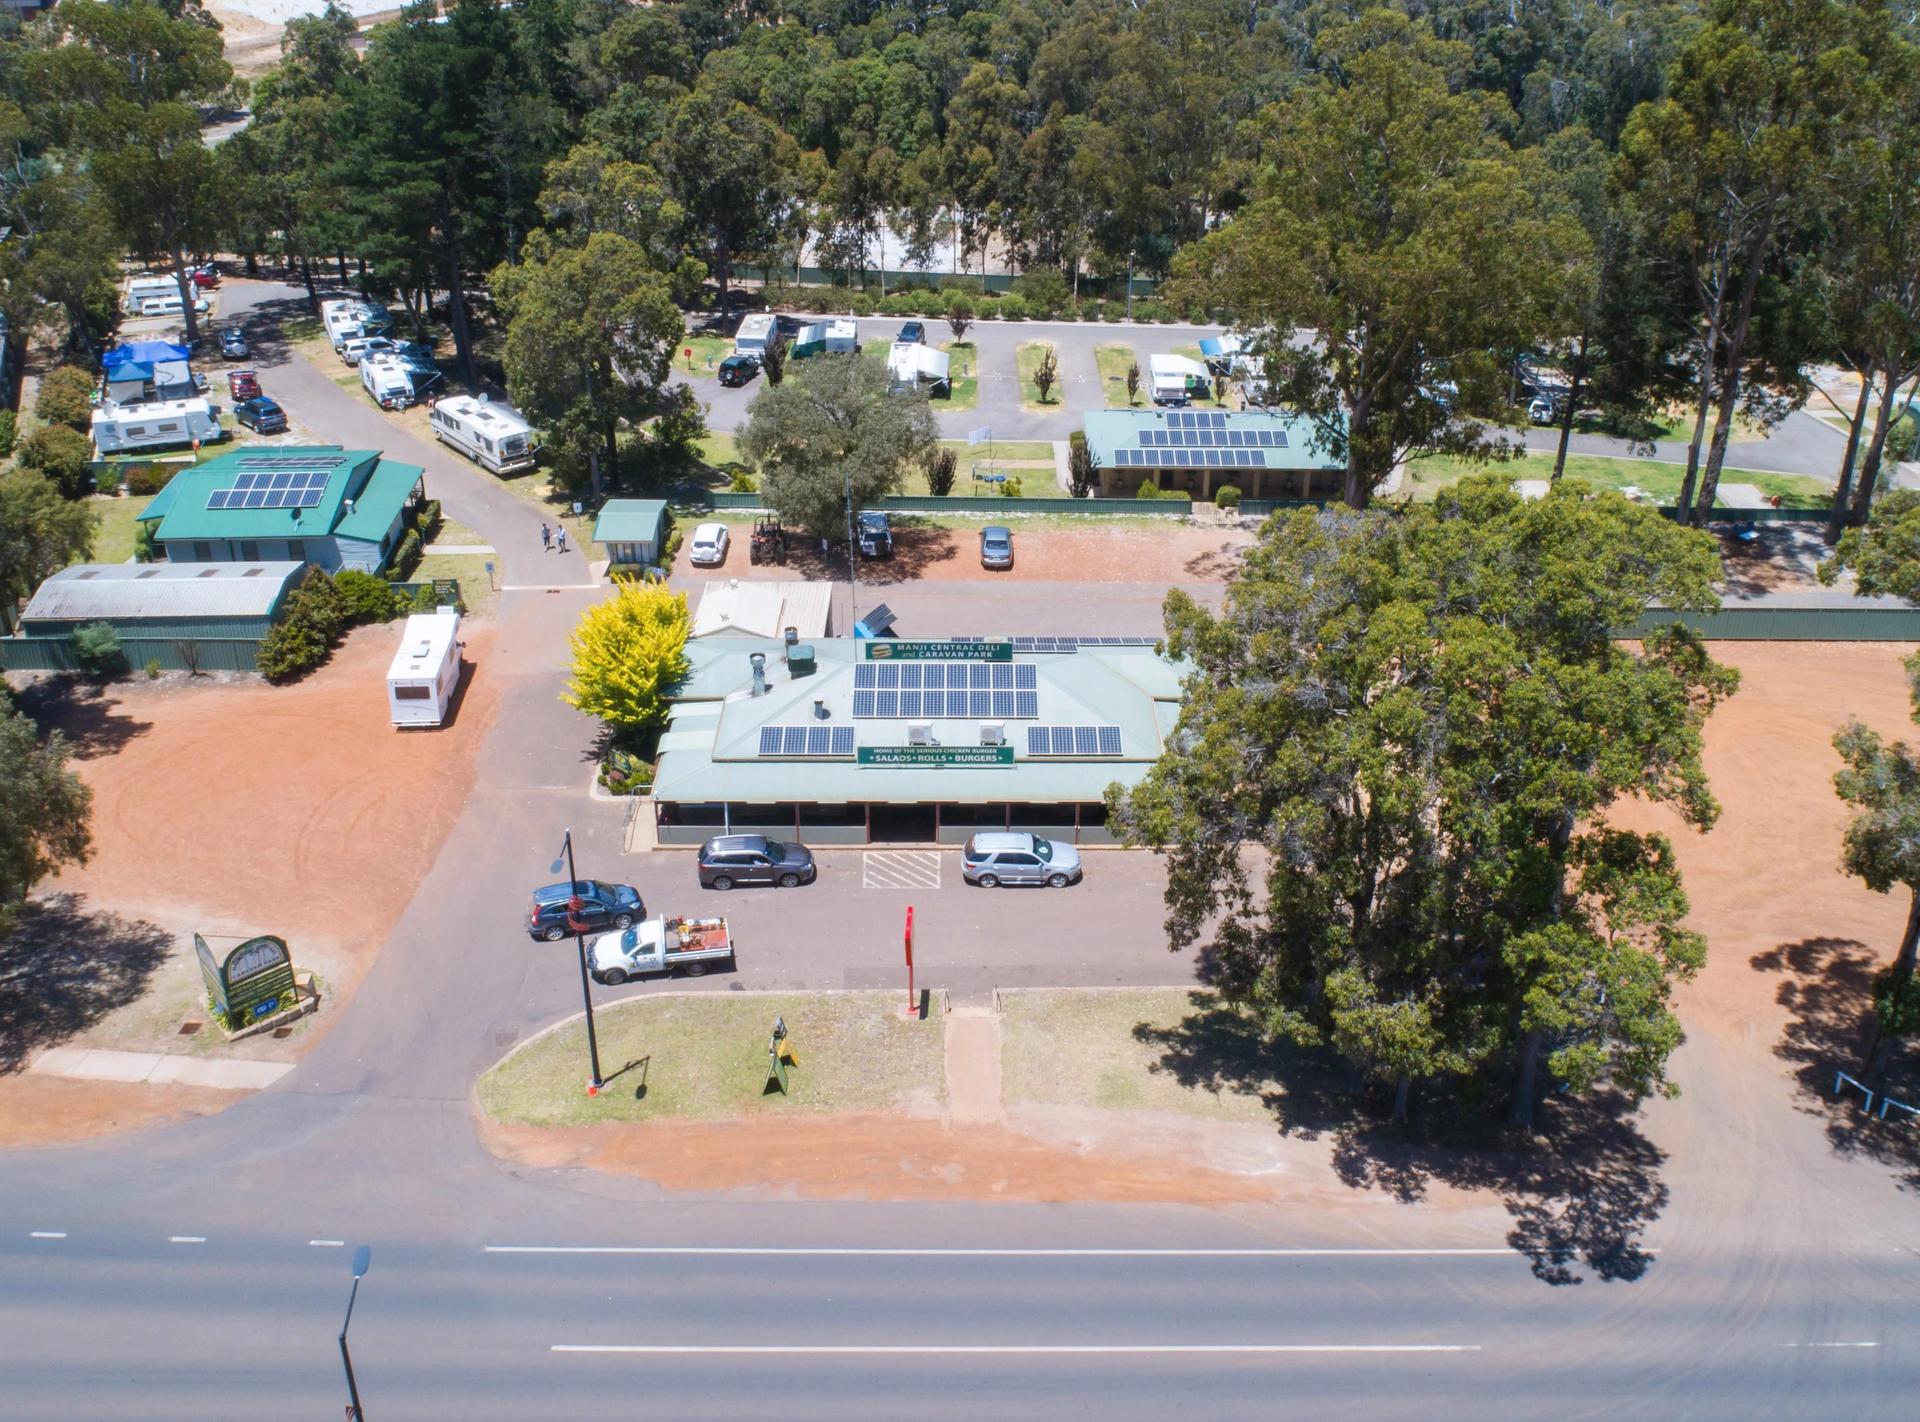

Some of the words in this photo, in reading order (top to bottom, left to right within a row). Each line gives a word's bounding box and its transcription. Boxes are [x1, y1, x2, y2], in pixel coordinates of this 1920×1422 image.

[875, 754, 912, 762] SALADS
[918, 754, 947, 762] ROLLS
[955, 754, 997, 762] BURGERS
